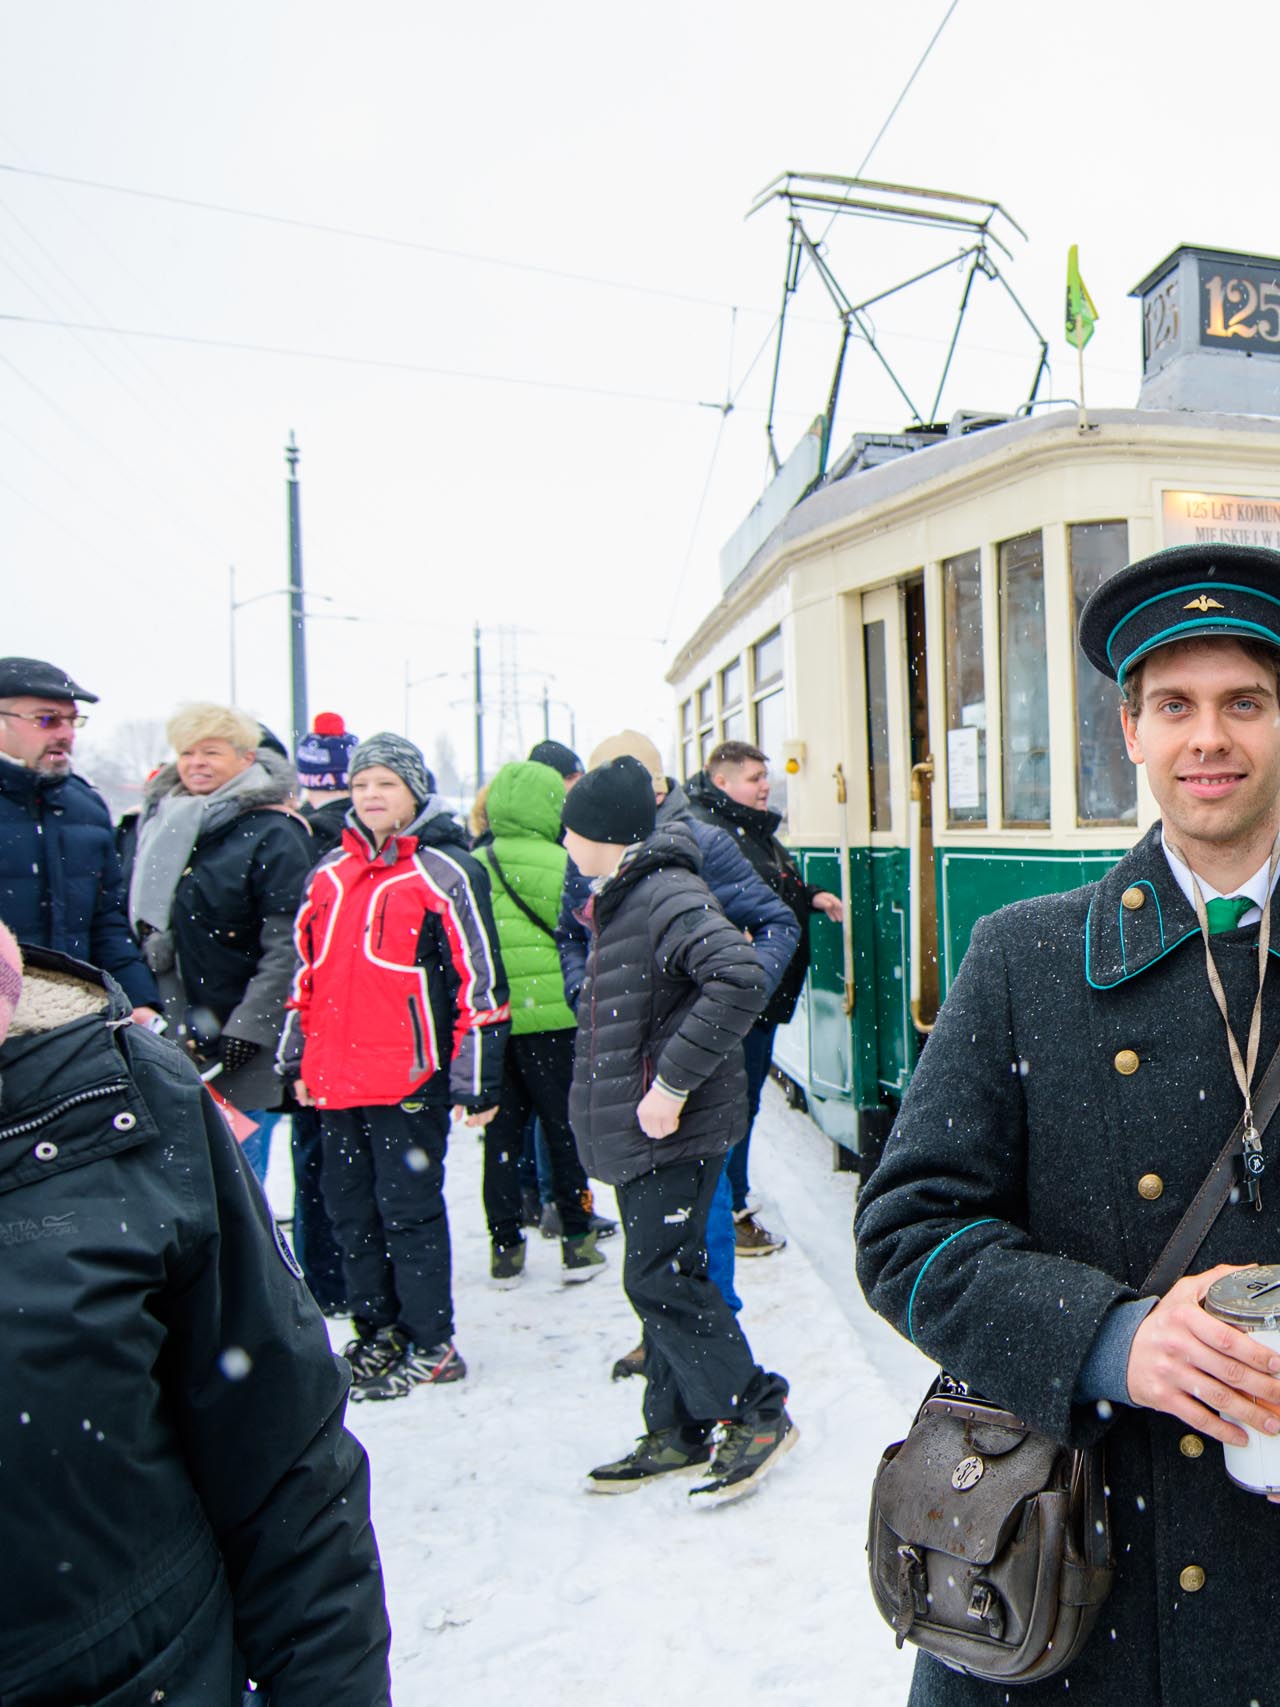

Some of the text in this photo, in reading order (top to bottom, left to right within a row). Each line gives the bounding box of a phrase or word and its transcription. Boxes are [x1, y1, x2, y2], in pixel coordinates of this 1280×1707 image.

[1186, 501, 1208, 519] 125
[1211, 502, 1233, 521] LAT
[1261, 529, 1272, 547] W
